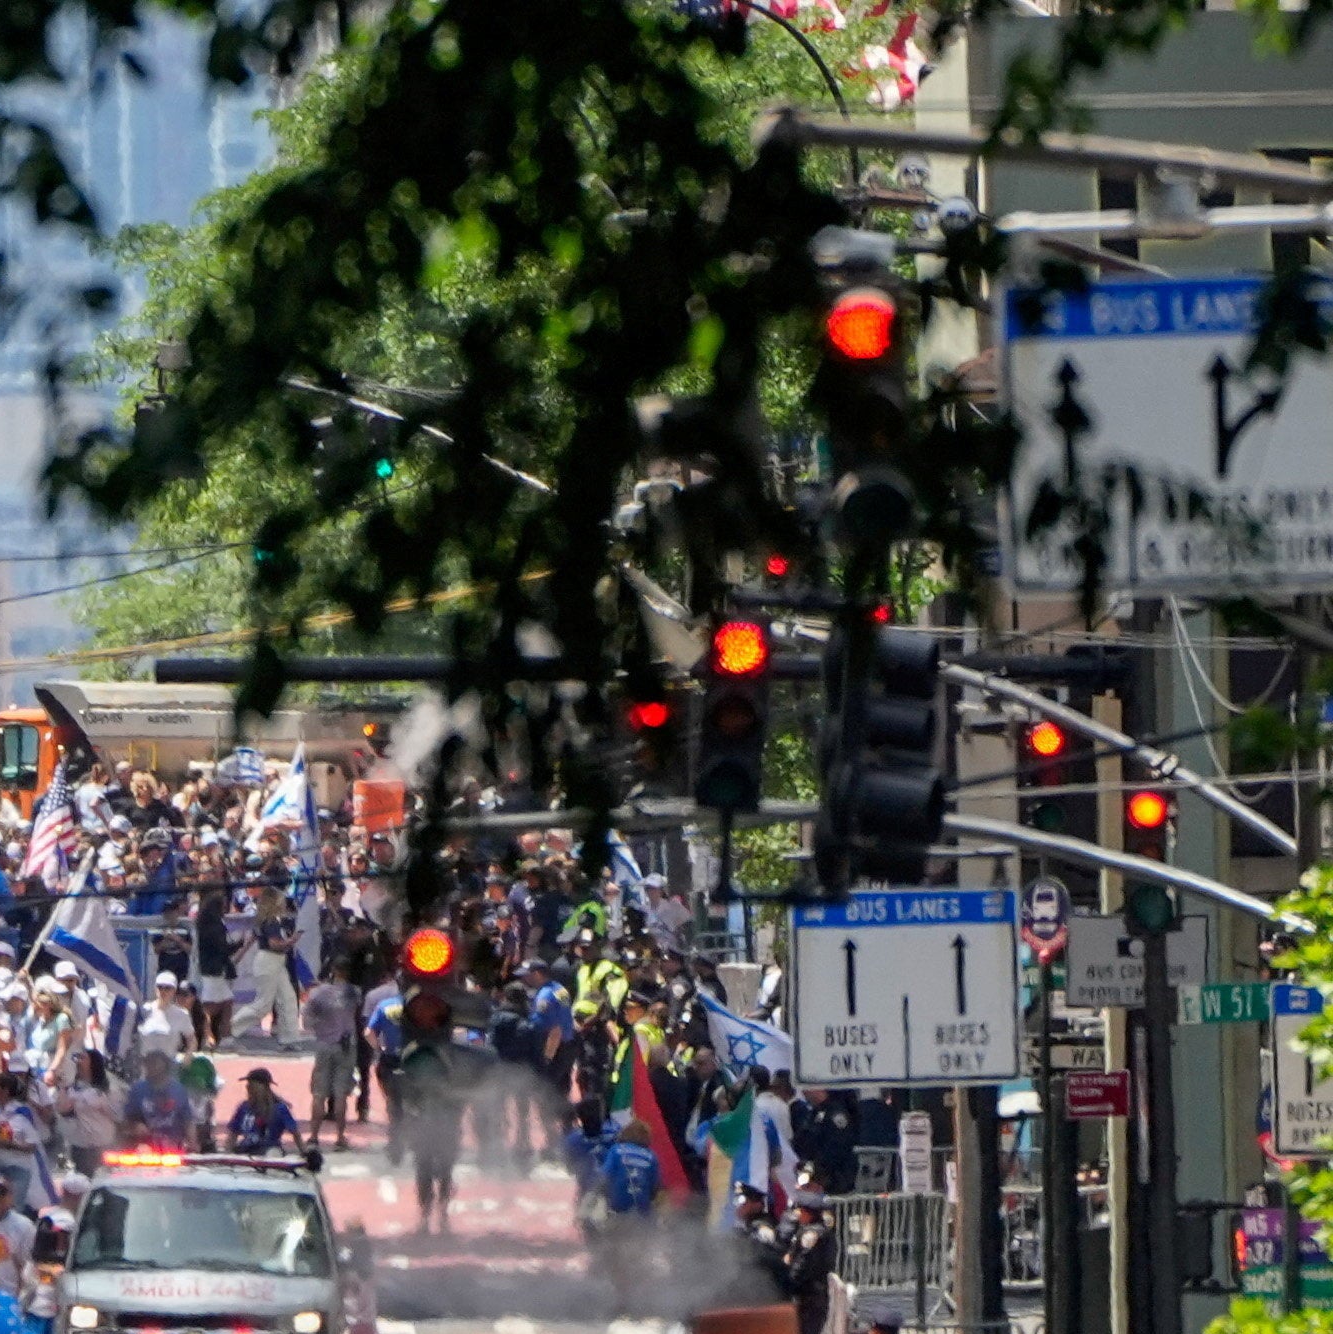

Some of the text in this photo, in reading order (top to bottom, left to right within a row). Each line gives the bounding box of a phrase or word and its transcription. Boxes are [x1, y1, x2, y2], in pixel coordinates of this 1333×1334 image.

[1091, 292, 1159, 333] BUS
[845, 894, 961, 922] BUS LANES
[1203, 989, 1221, 1019] W
[824, 1024, 878, 1047] BUSES
[935, 1022, 990, 1046] BUSES
[830, 1053, 876, 1075] ONLY
[939, 1051, 985, 1072] ONLY
